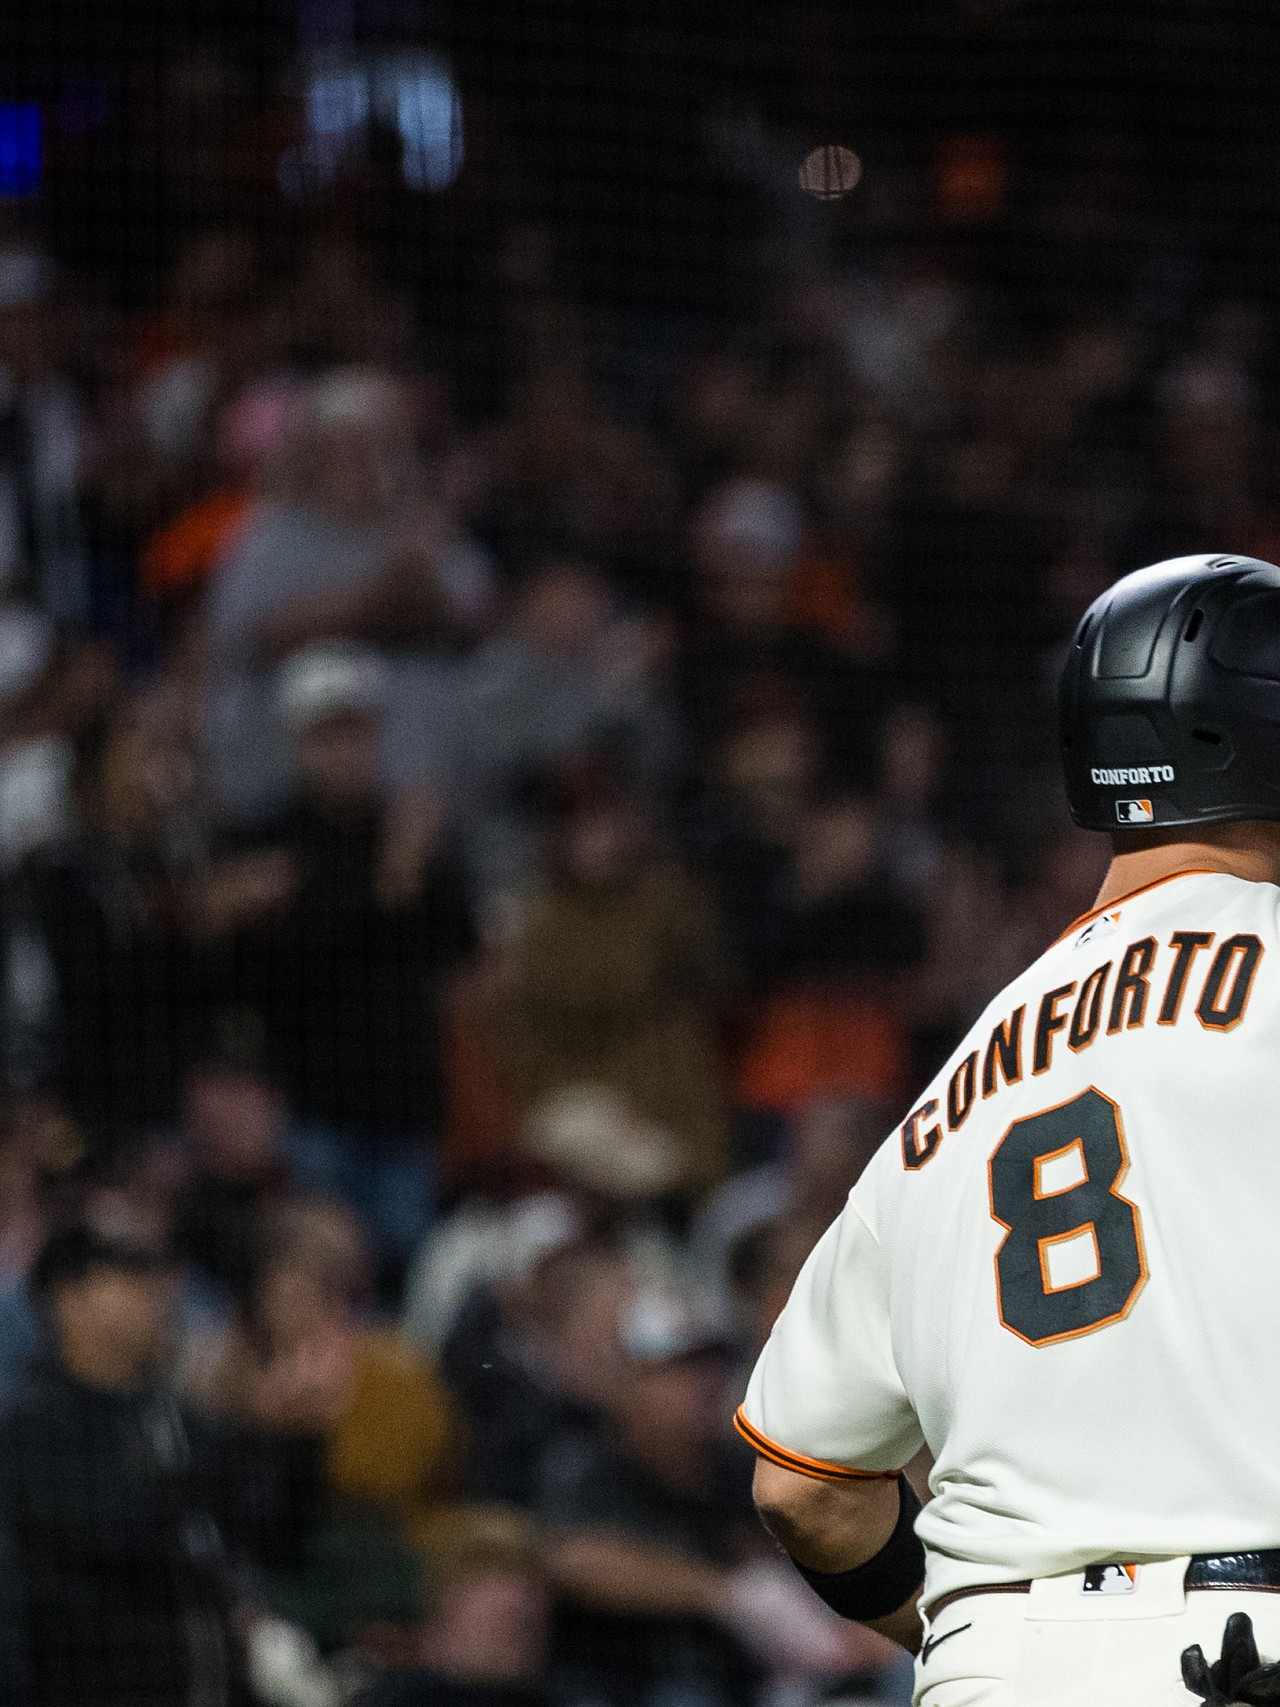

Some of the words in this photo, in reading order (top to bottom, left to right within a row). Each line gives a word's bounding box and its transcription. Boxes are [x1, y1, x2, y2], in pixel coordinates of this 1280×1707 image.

[1091, 765, 1175, 785] CONFORTO
[902, 931, 1265, 1170] CONFORTO
[987, 1085, 1150, 1347] 8
